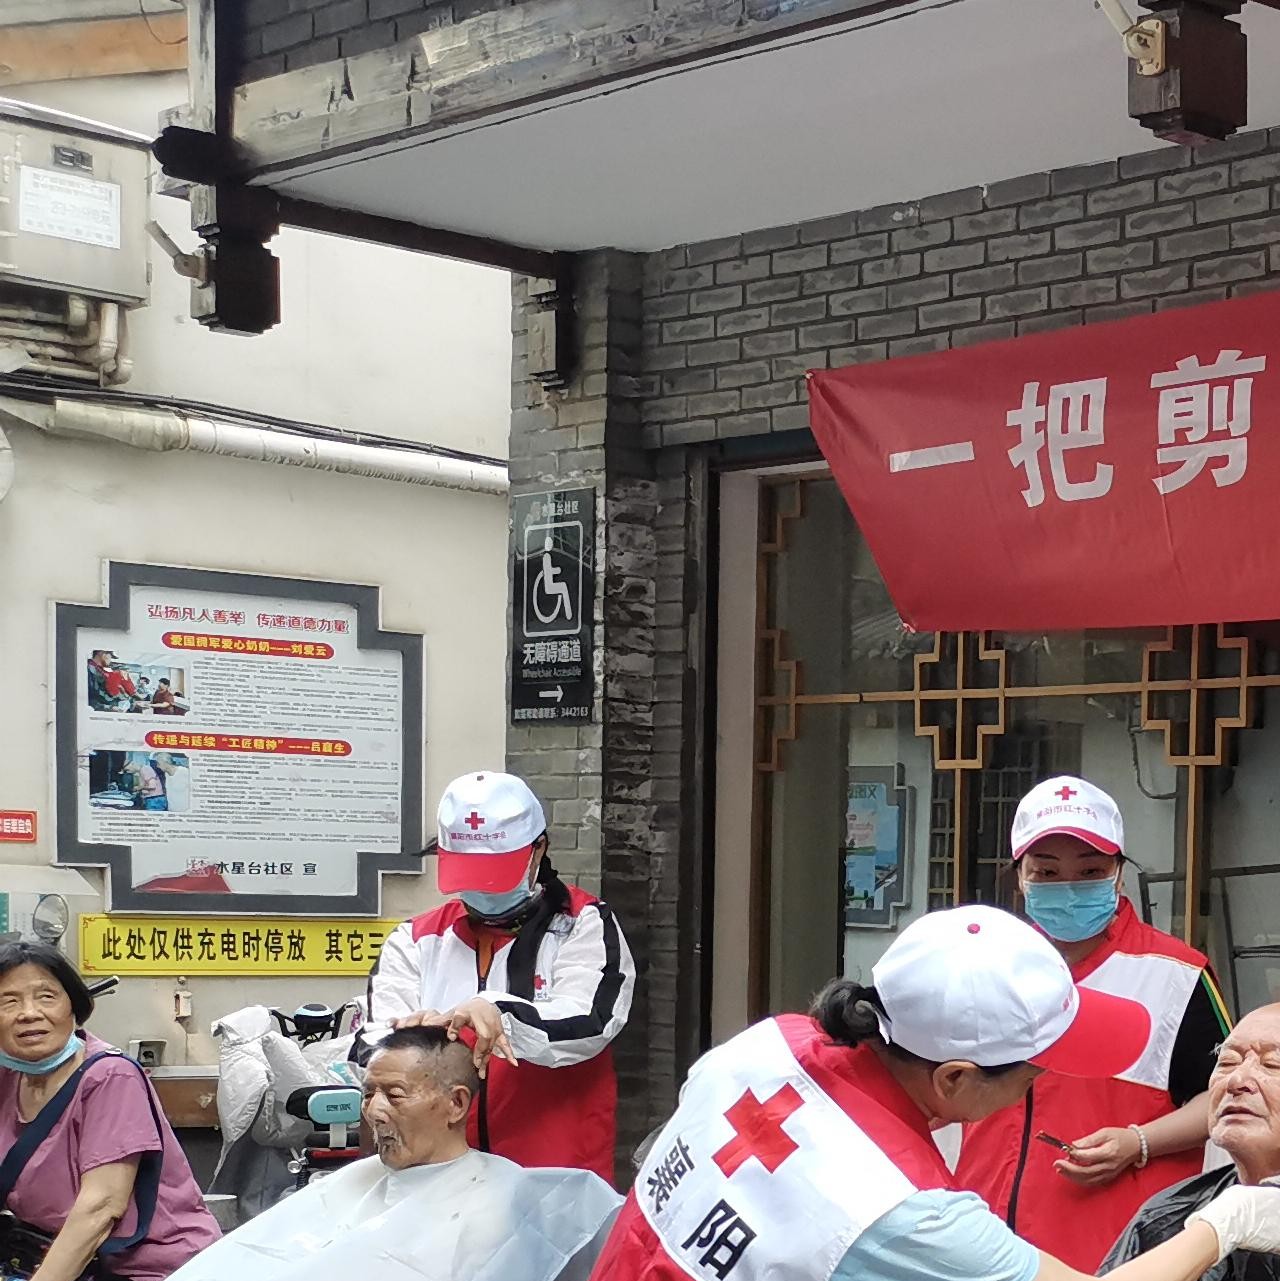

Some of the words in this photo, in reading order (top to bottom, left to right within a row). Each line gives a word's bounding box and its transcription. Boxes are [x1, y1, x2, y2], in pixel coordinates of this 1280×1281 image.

[147, 604, 246, 625] 弘扬凡人善举
[256, 612, 349, 634] 传递道德力量
[522, 638, 582, 665] 无障碍通道
[215, 861, 294, 875] 水星台社区
[302, 862, 318, 876] 宣
[101, 927, 307, 963] 此处仅供充电时停放
